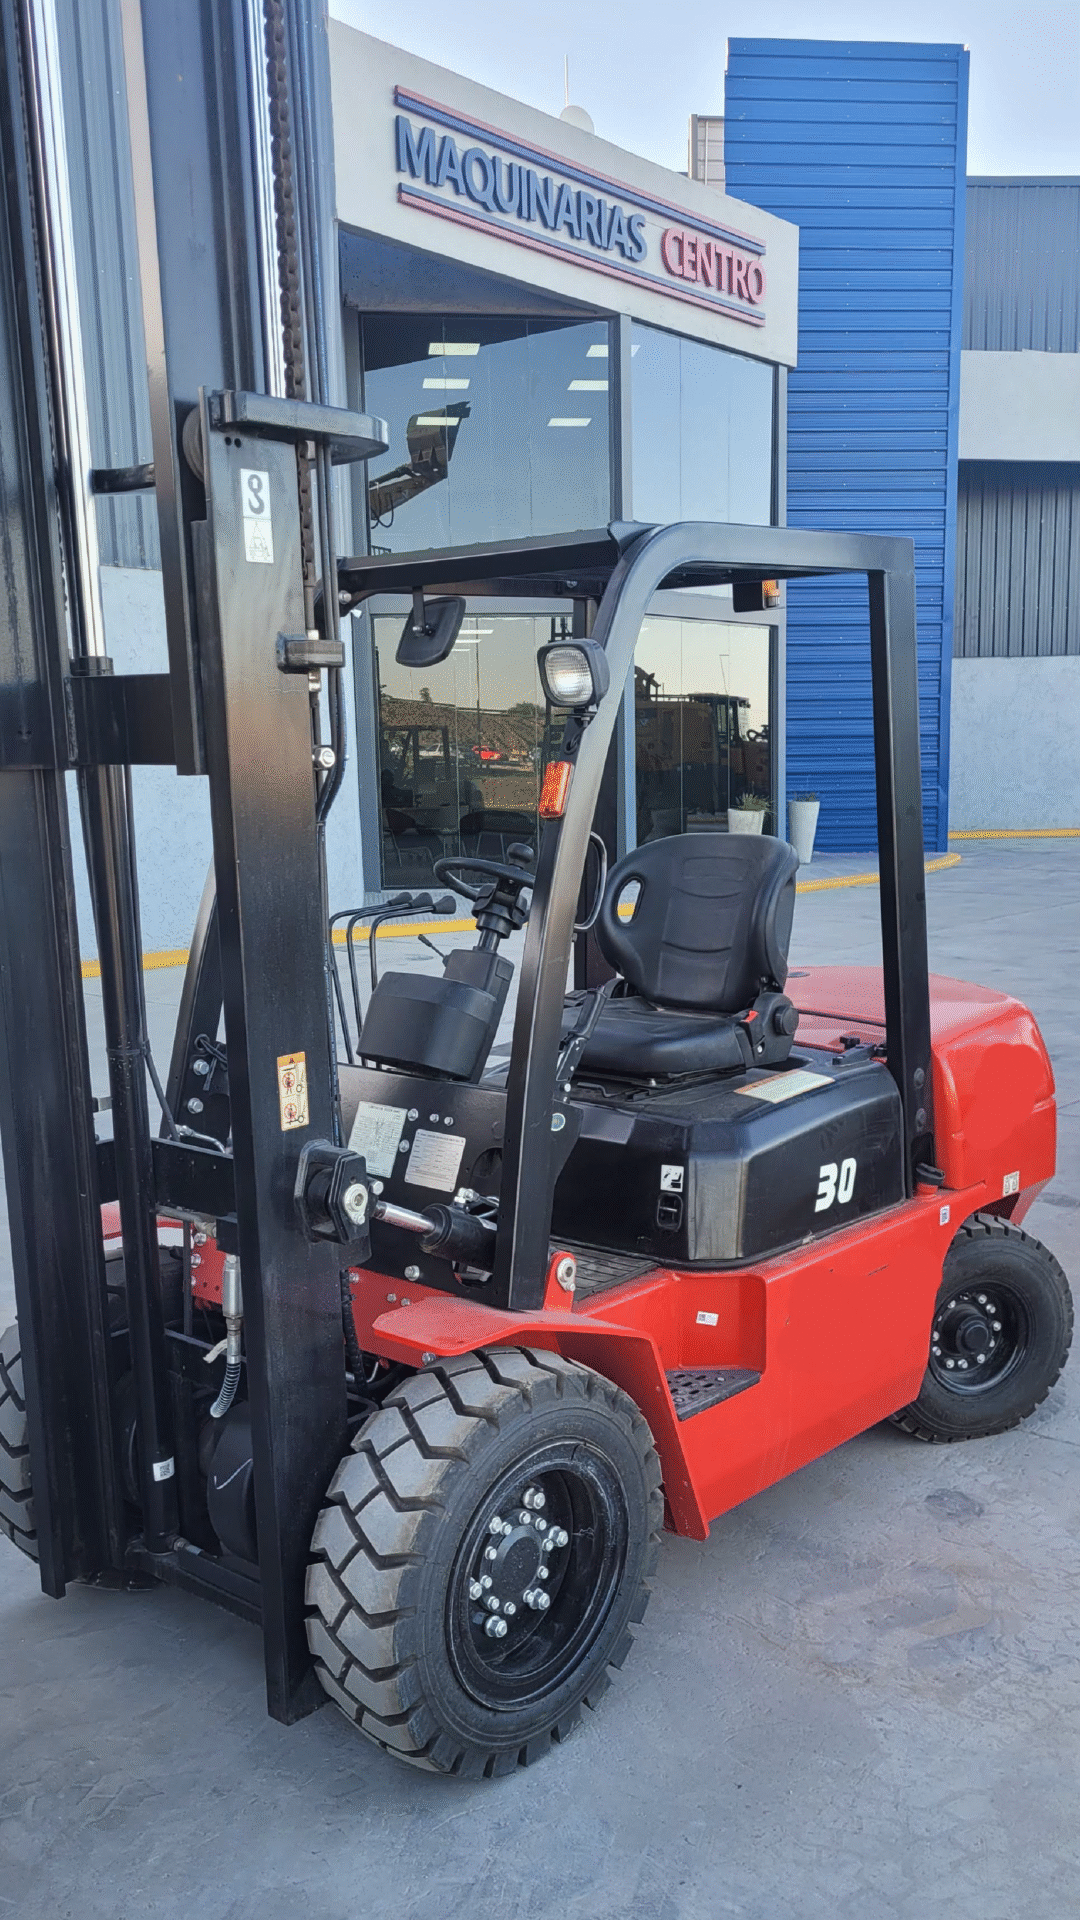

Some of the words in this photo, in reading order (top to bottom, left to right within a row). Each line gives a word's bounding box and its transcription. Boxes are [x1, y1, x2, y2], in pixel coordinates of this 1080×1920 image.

[395, 115, 648, 262] MAQUINARIAS
[661, 227, 767, 304] CENTRO
[814, 1157, 857, 1213] 30
